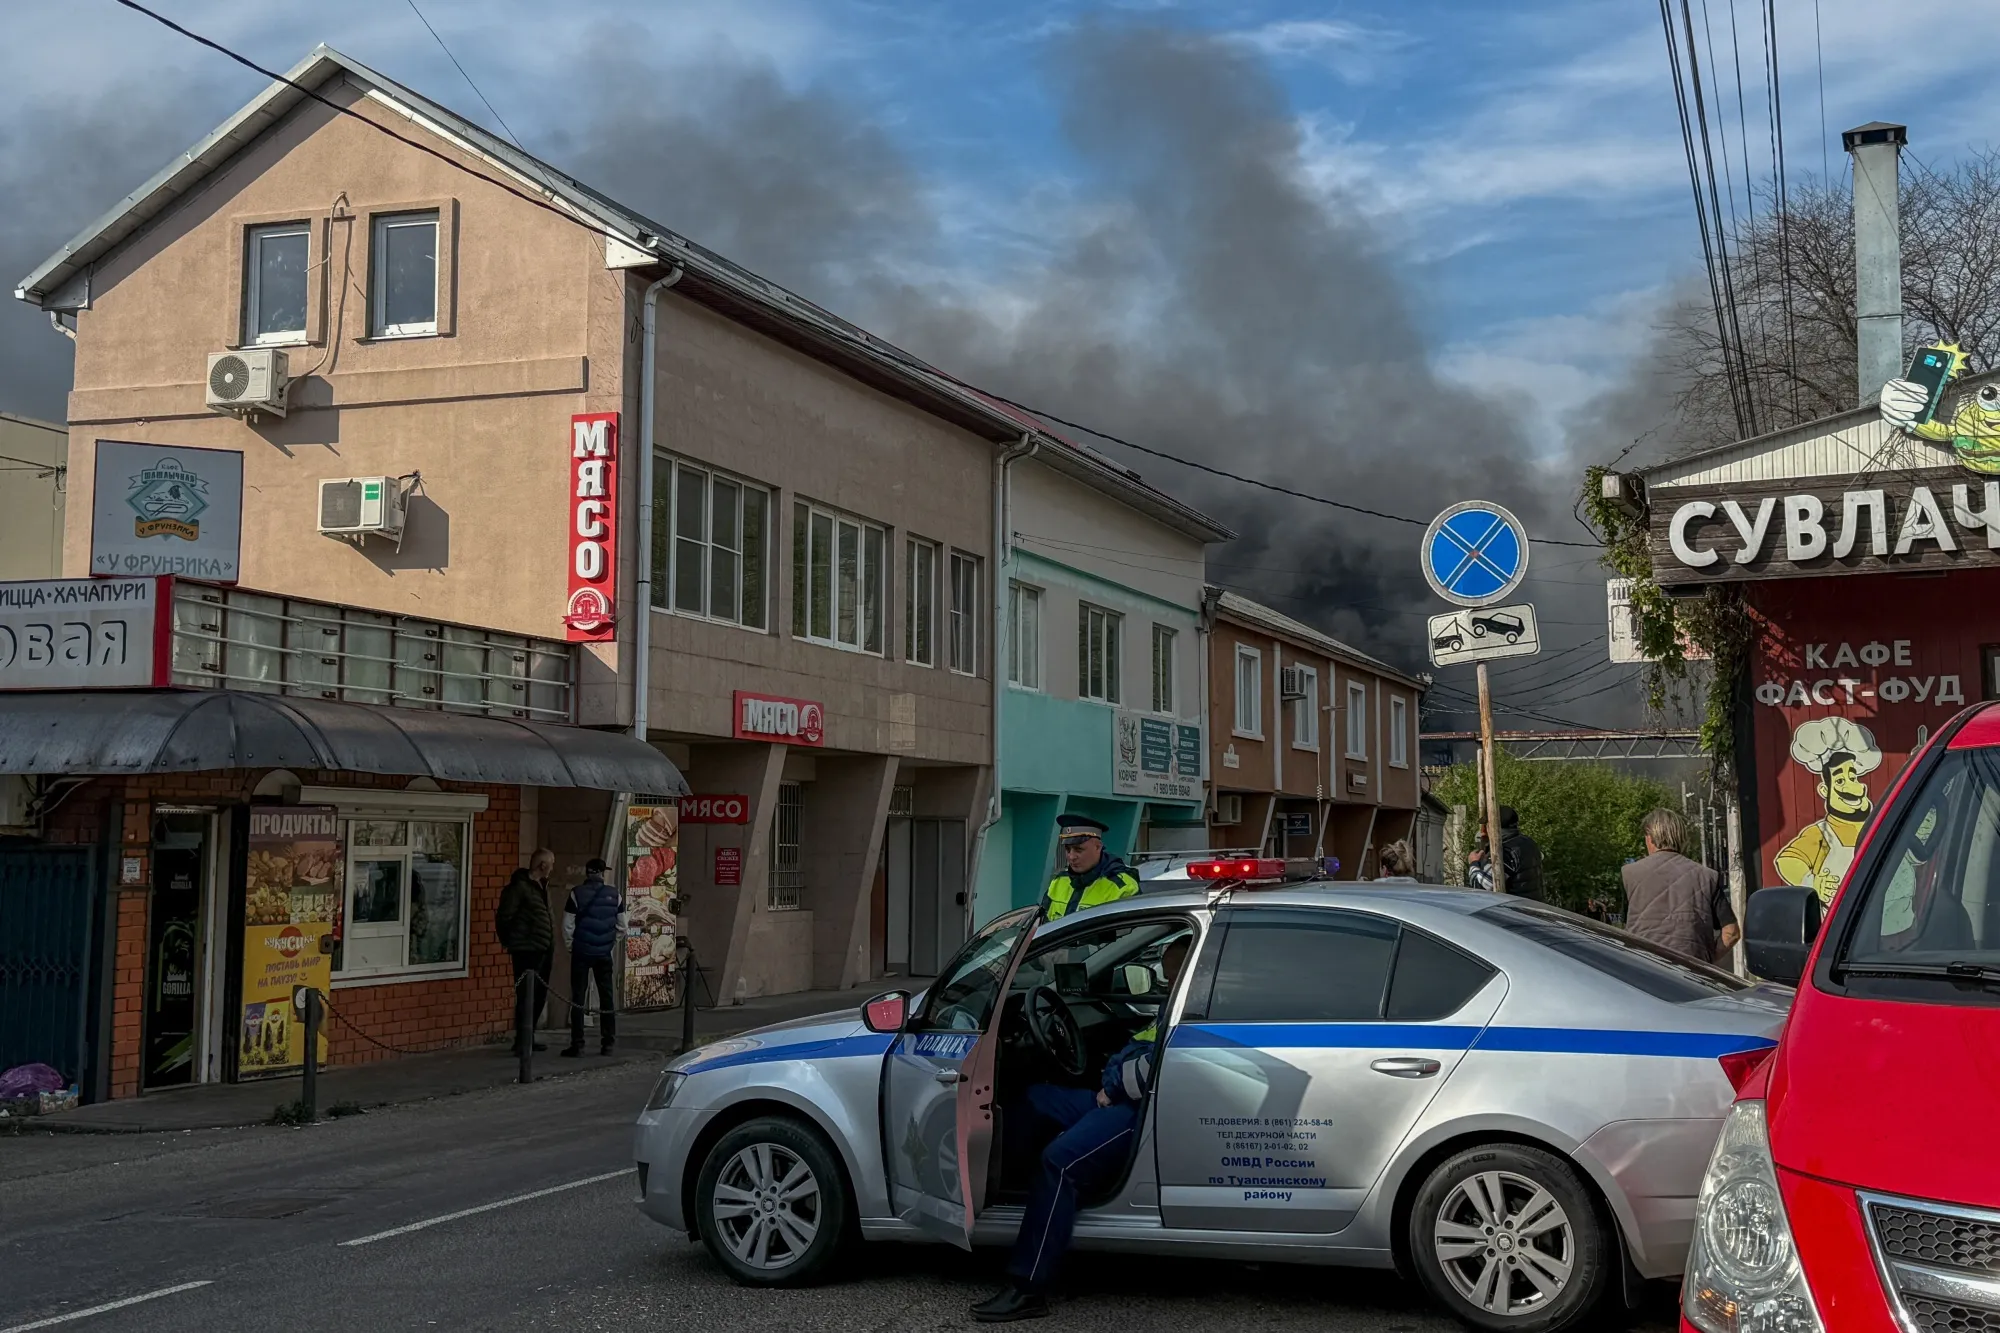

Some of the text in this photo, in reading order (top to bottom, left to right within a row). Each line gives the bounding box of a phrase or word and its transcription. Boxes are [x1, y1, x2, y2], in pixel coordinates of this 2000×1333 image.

[144, 471, 195, 483] ШАШЛЫЧНАЯ
[573, 420, 610, 579] МЯСО
[147, 522, 194, 537] ФРУНЗИКА
[1805, 639, 1912, 670] КАФЕ
[1755, 674, 1965, 707] ФАСТ-ФУД
[742, 698, 798, 736] МЯСО
[681, 799, 742, 818] МЯСО
[250, 814, 337, 838] ПРОДУКТЫ
[265, 959, 299, 974] ПОСТАВЬ
[163, 982, 191, 995] GORILLA
[257, 977, 269, 989] НА
[916, 1034, 968, 1056] ПОЛИЦИЯ
[1199, 1117, 1333, 1128] ТЕЛ.ДОВЕРИЯ: 8 (861) 224-58-48
[1217, 1130, 1317, 1140] ТЕЛ.ДЕЖУРНОЙ ЧАСТИ
[1226, 1142, 1231, 1150] 8
[1233, 1142, 1262, 1151] (86167)
[1264, 1142, 1296, 1151] 2-01-02;
[1221, 1156, 1315, 1169] ОМВД России
[1208, 1175, 1327, 1188] по Туапсинскому
[1244, 1189, 1293, 1202] району
